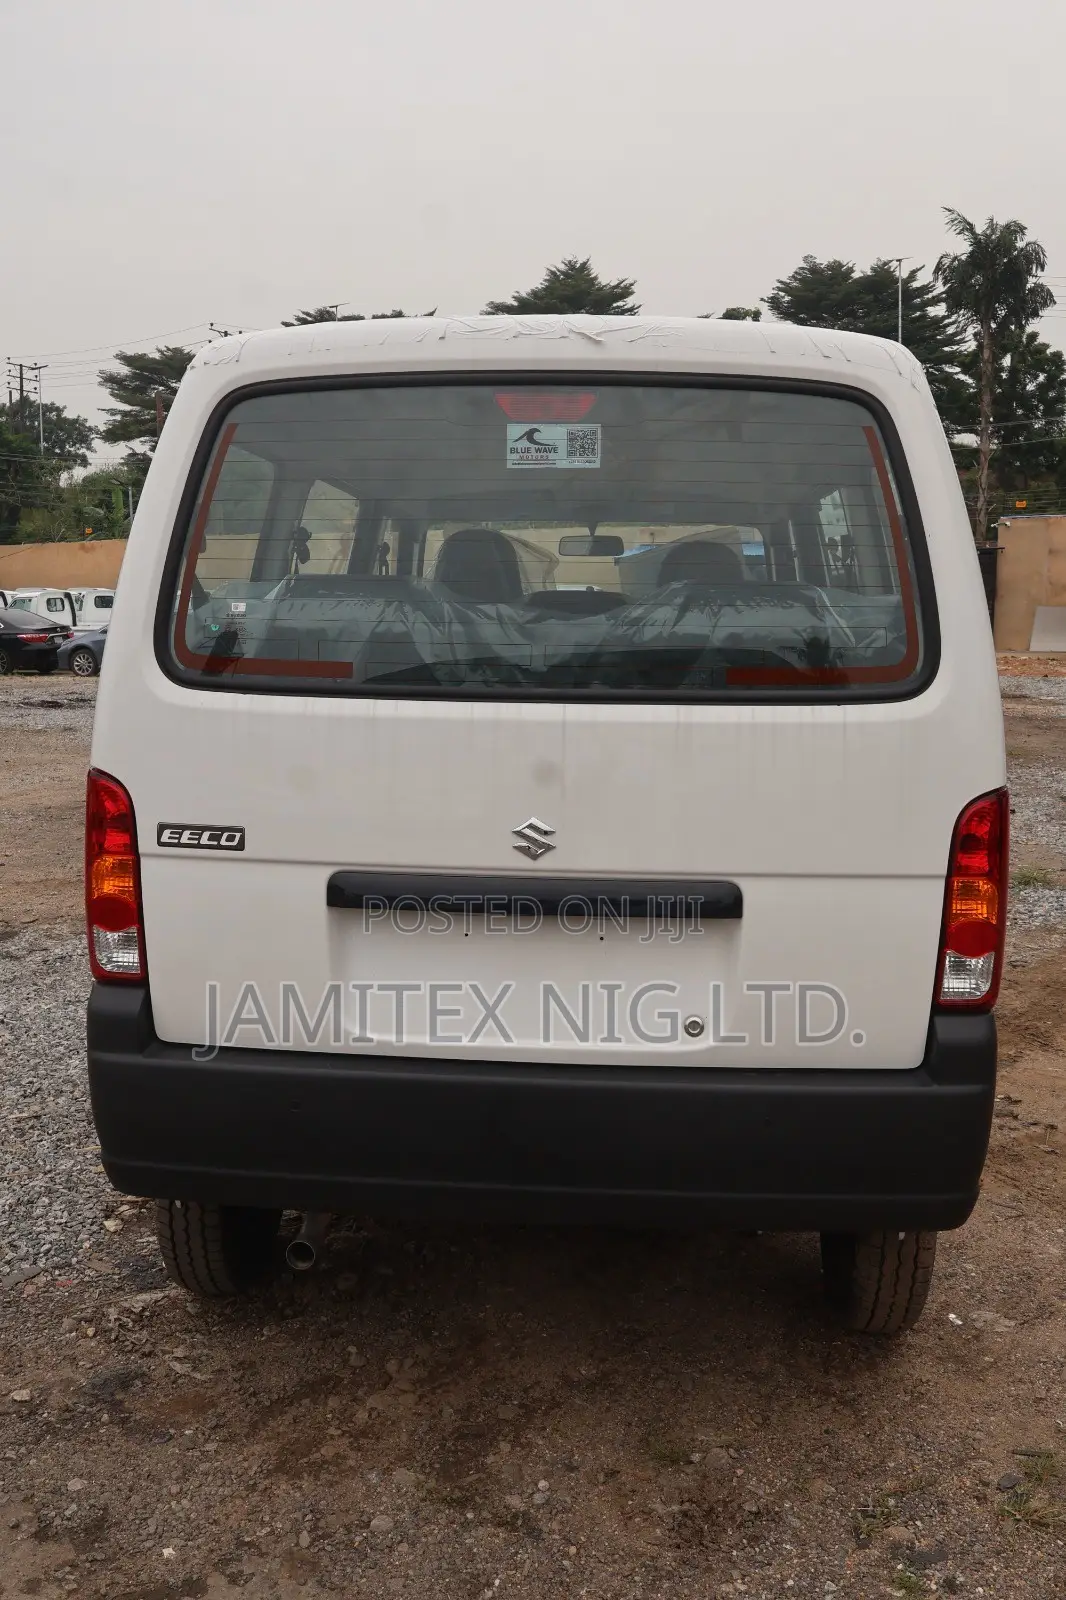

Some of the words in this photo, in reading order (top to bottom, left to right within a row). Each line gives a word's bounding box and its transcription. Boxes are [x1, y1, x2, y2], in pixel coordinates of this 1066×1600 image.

[509, 446, 532, 454] BLUE
[534, 446, 559, 454] WAVE
[160, 828, 243, 846] EECO
